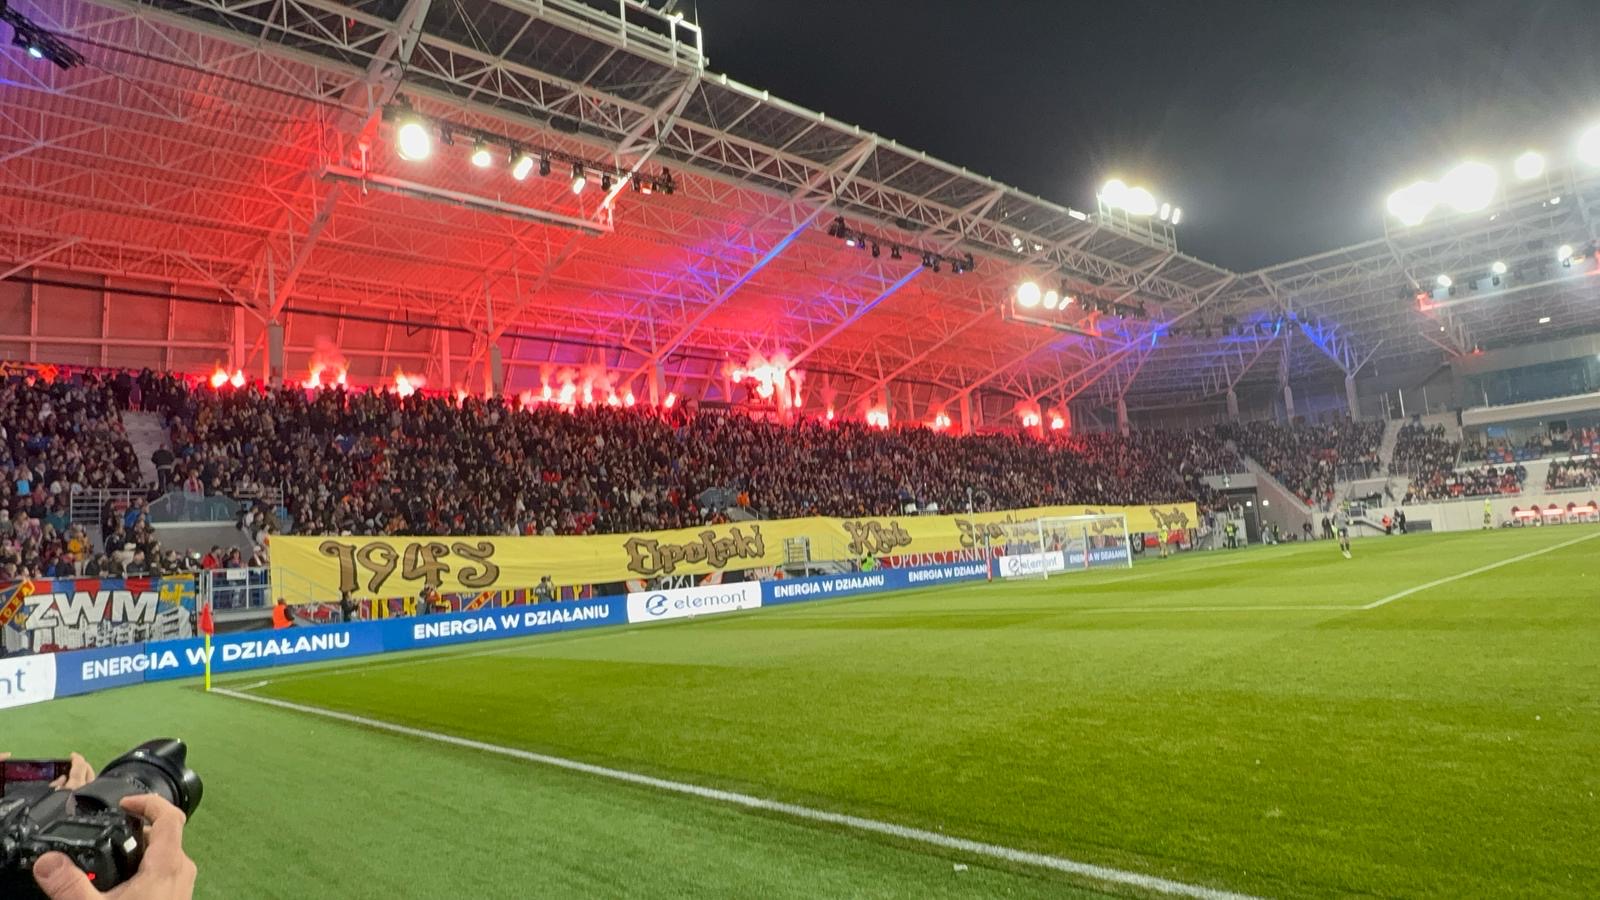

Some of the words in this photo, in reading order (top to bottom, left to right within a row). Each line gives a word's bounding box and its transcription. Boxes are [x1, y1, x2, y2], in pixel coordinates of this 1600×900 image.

[318, 541, 500, 594] 1945
[908, 569, 943, 583] ENERGIA
[944, 568, 952, 578] W
[954, 564, 988, 577] DZIAŁANI
[674, 589, 747, 610] elemont
[774, 581, 820, 598] ENERGIA
[822, 580, 833, 593] W
[835, 575, 884, 592] DZIAŁANIU
[24, 590, 160, 630] ZWM
[414, 617, 497, 640] ENERGIA
[501, 614, 520, 629] W
[525, 604, 609, 627] DZIAŁANIU
[82, 650, 178, 680] ENERGIA
[186, 646, 214, 665] W
[222, 632, 350, 661] DZIAŁANIU
